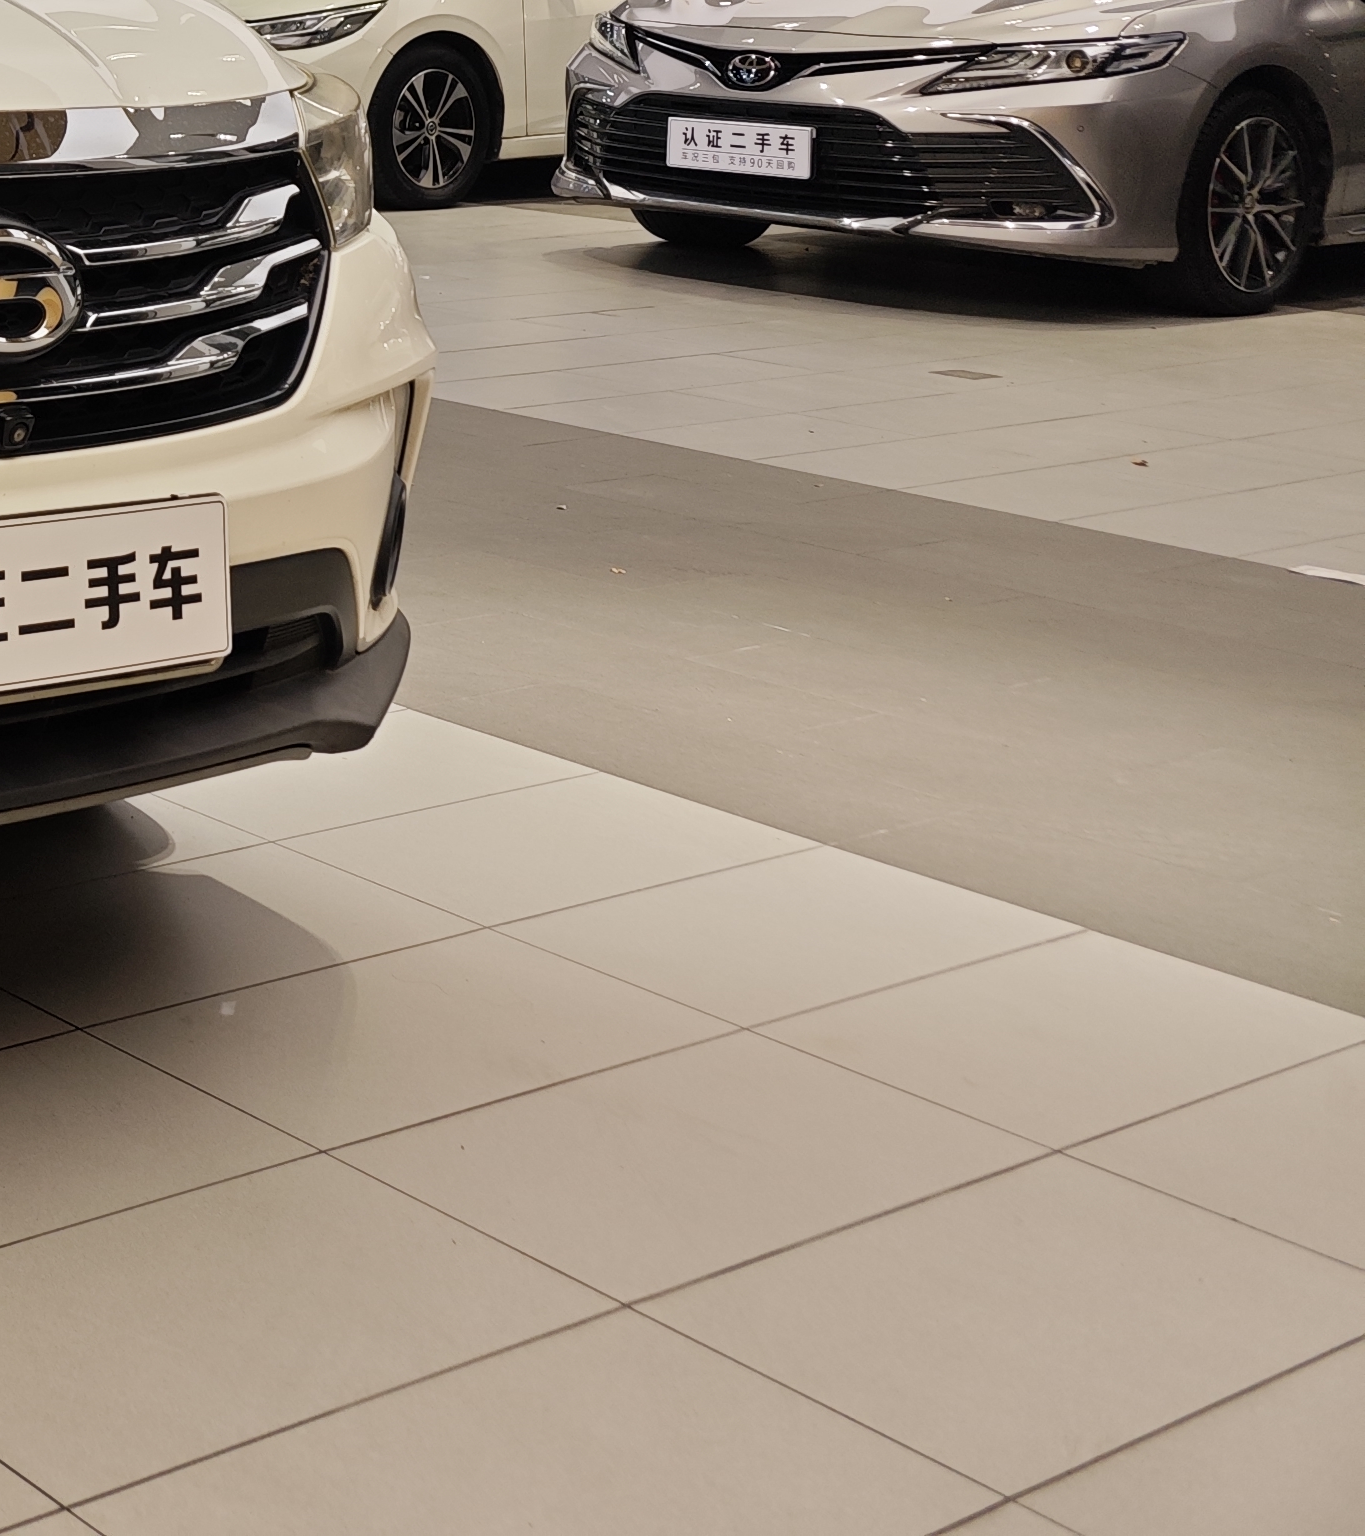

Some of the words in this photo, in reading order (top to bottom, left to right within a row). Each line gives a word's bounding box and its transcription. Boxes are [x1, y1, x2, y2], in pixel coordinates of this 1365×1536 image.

[682, 126, 796, 156] 认证二手车
[681, 151, 720, 164] 车况三包
